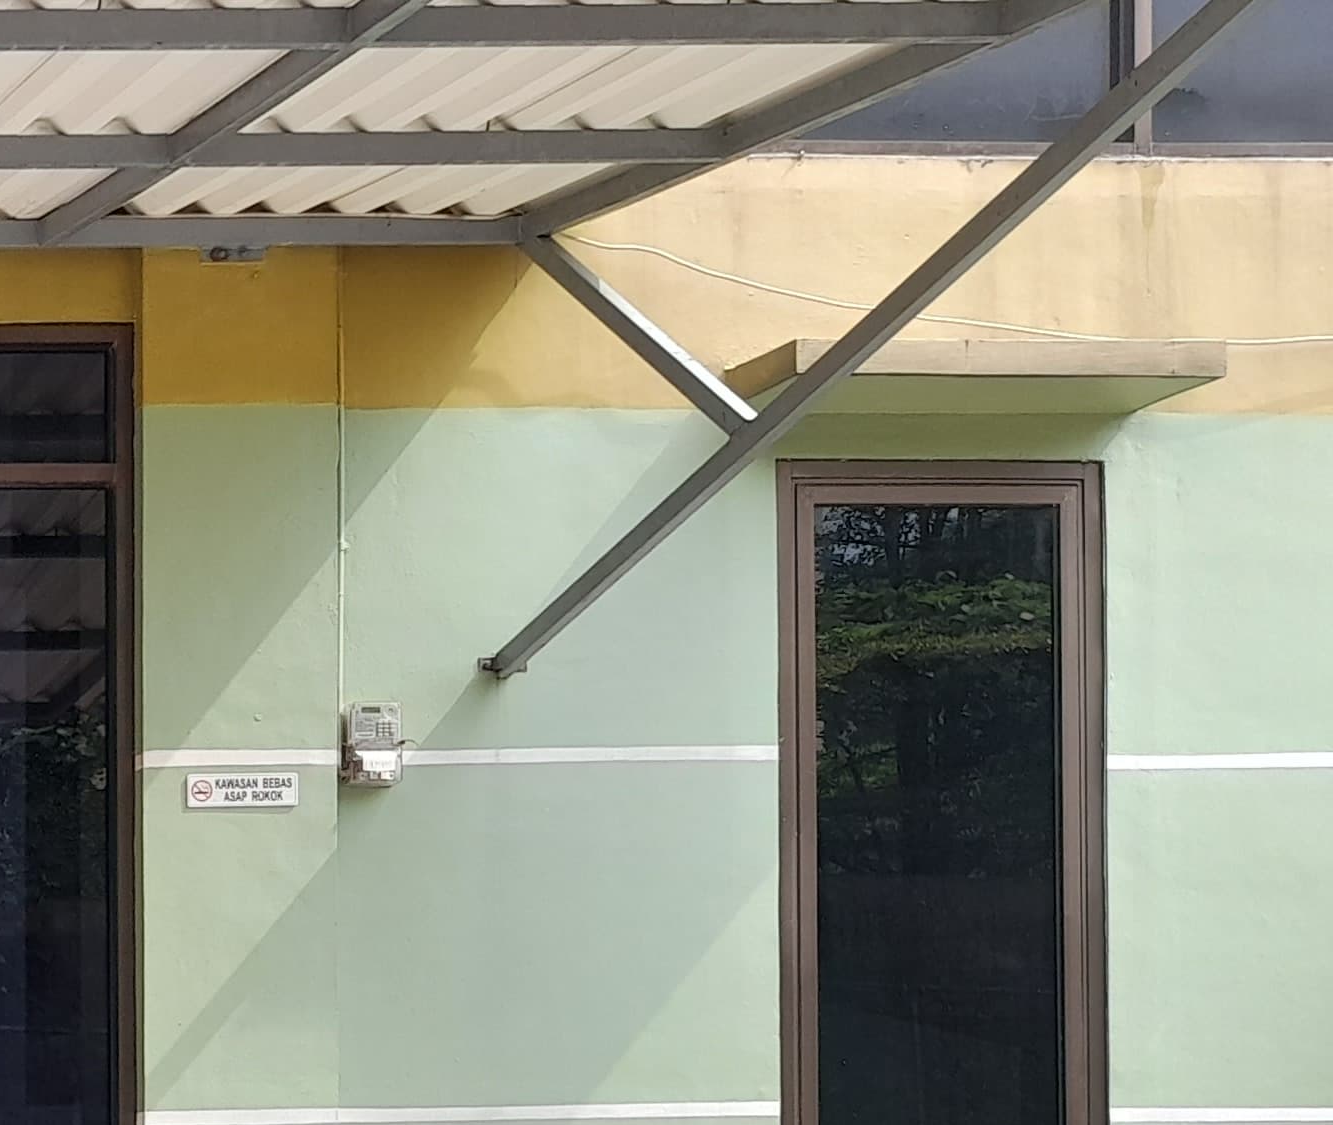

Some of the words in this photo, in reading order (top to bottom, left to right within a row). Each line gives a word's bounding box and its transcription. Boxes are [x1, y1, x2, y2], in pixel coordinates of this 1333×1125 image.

[214, 778, 258, 790] KAWASAN
[262, 777, 293, 789] BEBAS
[224, 791, 248, 802] ASAP
[251, 790, 284, 802] ROKOK
